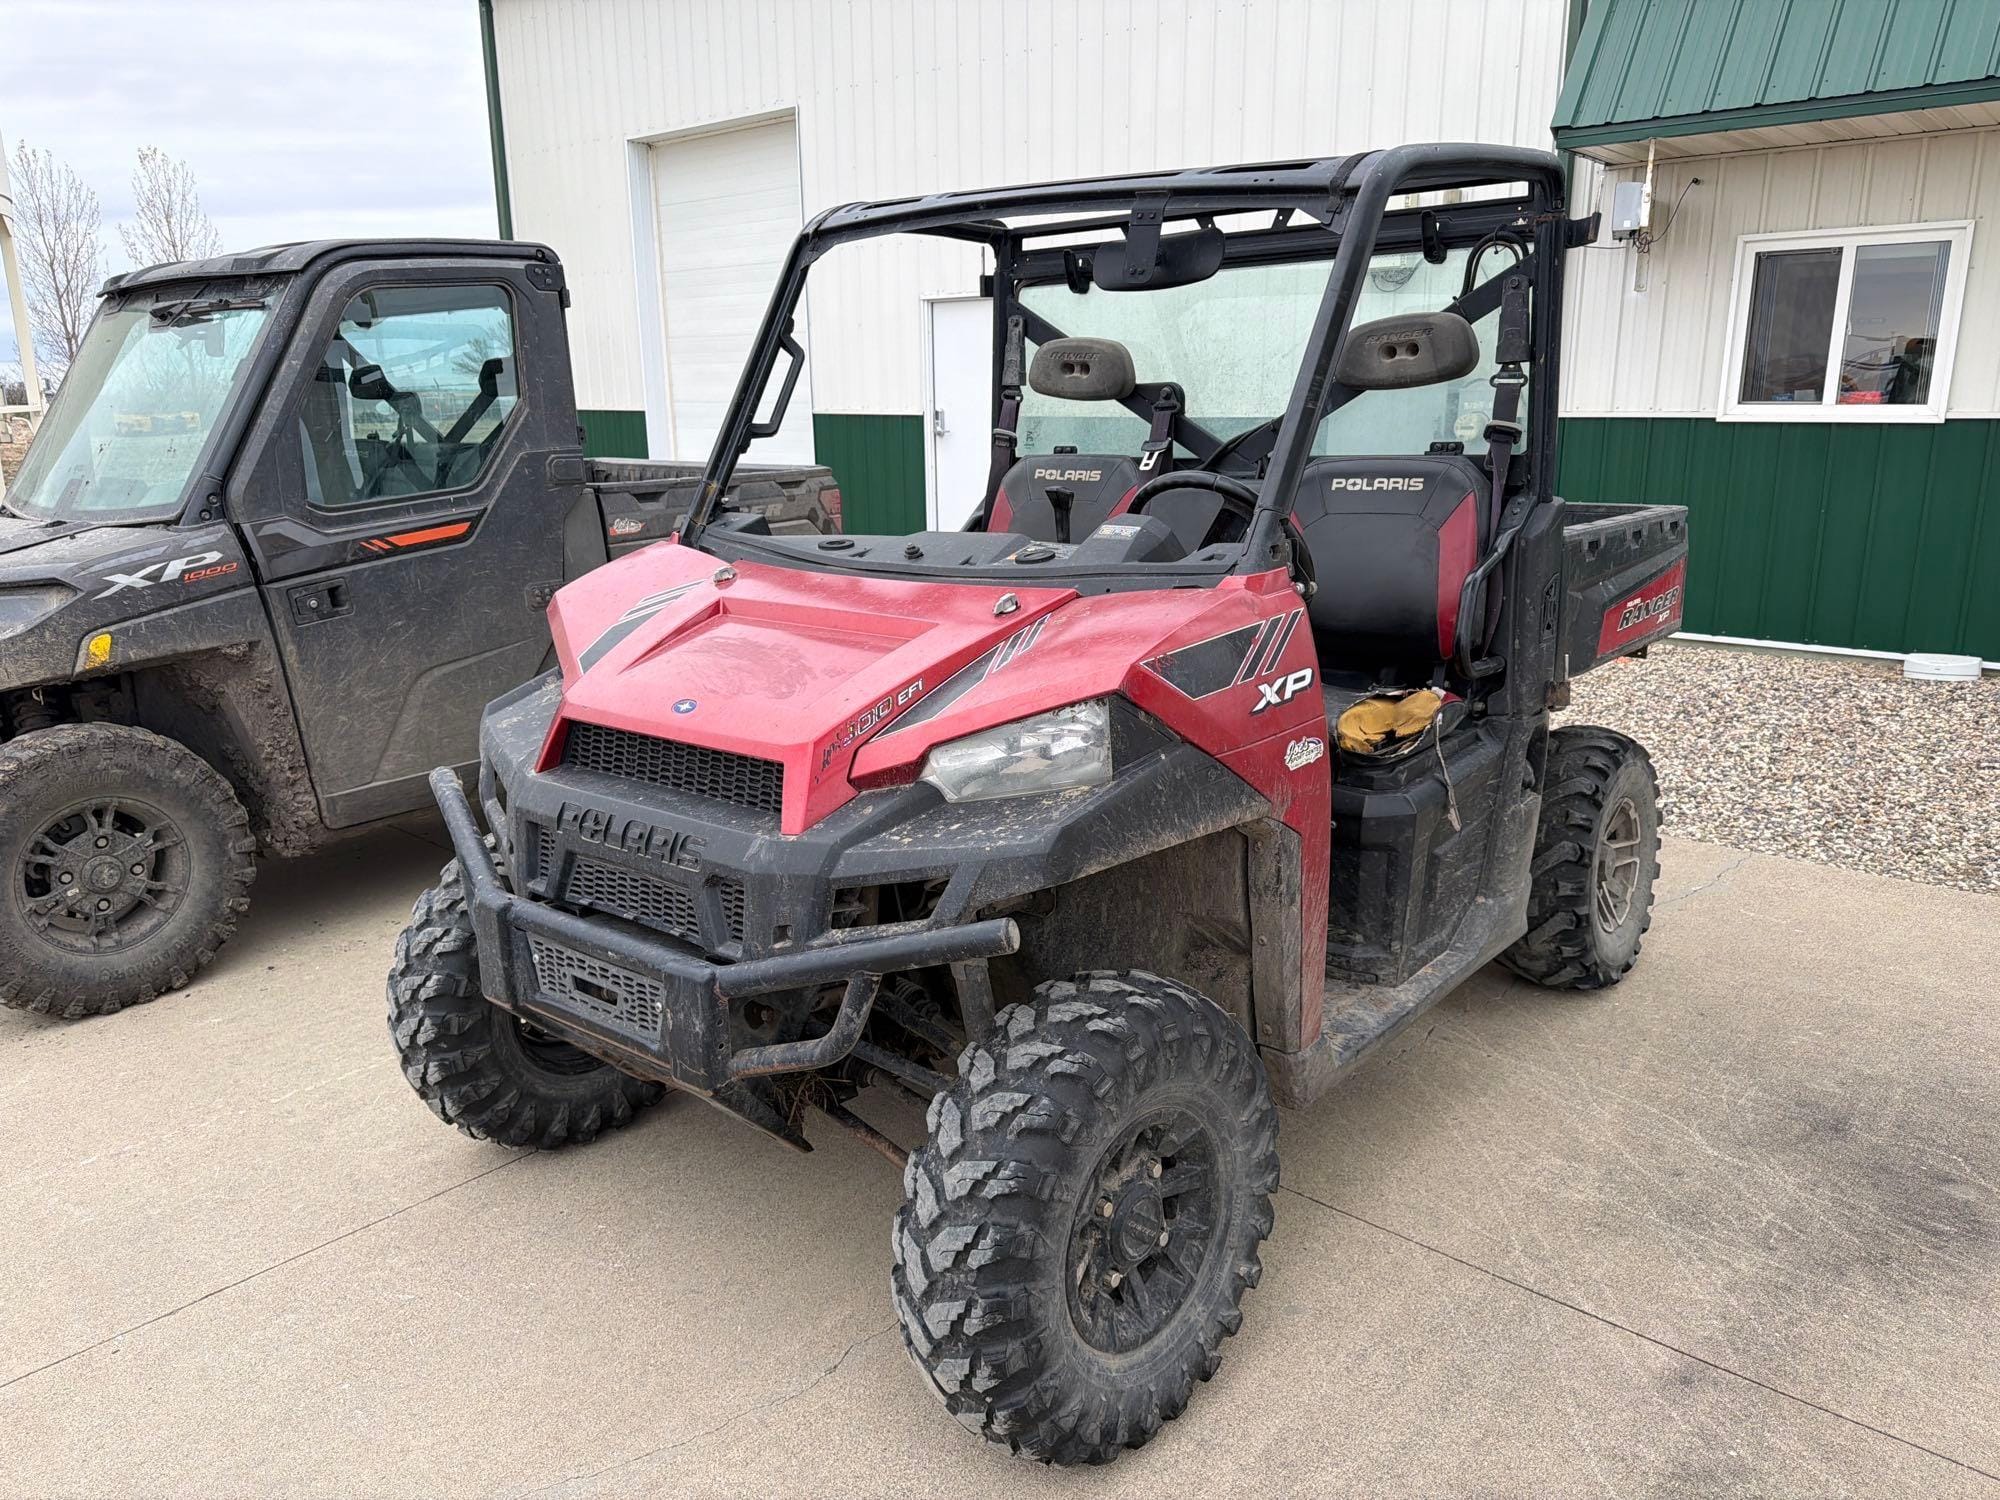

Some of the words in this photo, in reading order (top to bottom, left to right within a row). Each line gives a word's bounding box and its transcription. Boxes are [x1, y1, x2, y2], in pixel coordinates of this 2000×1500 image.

[1365, 327, 1434, 345] RANGER
[1034, 468, 1102, 482] POLARIS
[1331, 477, 1425, 491] POLARIS
[90, 550, 224, 601] XP
[183, 562, 239, 581] 1000
[1616, 585, 1680, 632] RANGER
[1656, 609, 1671, 625] XP
[1250, 667, 1315, 715] XP
[556, 800, 708, 873] POLARIS
